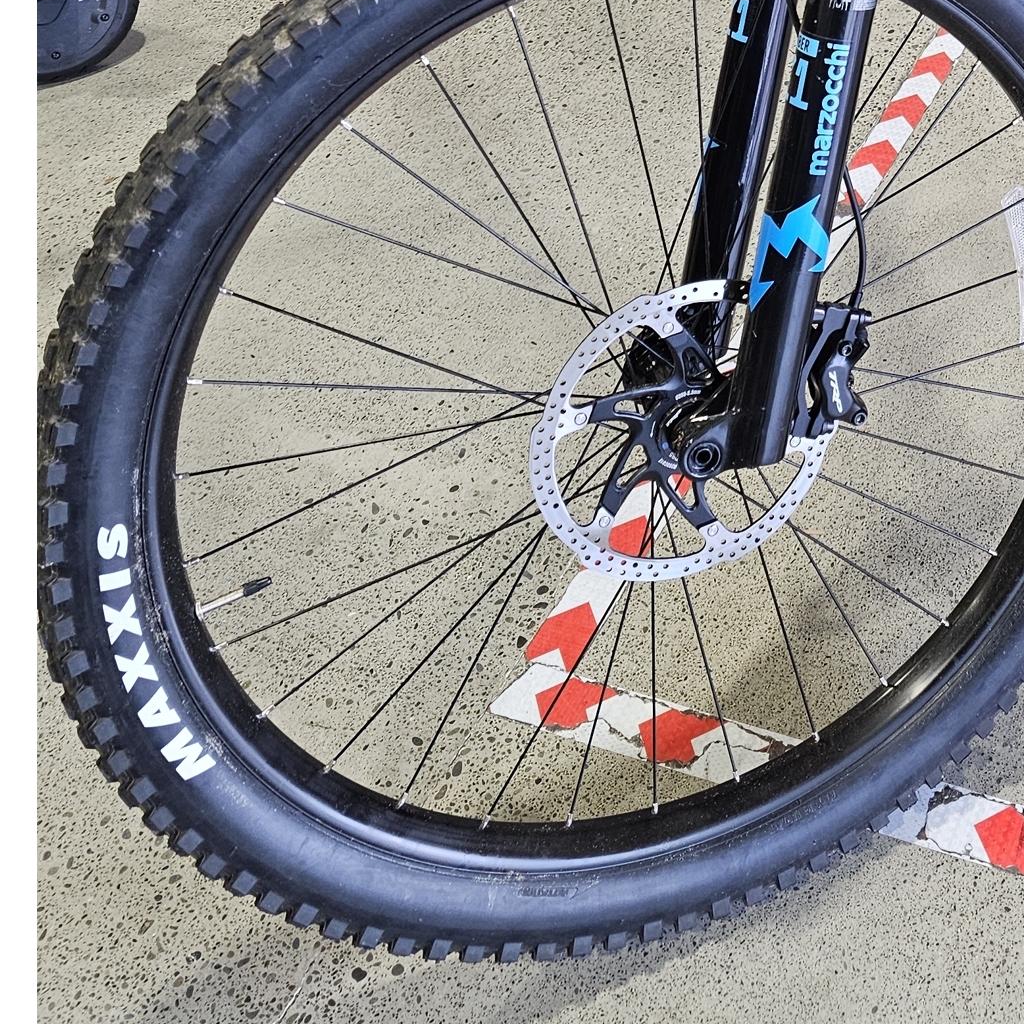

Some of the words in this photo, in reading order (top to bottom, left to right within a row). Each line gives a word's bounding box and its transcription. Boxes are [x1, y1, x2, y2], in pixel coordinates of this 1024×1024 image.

[809, 42, 850, 176] marzocchi
[828, 370, 844, 413] TRP
[97, 523, 217, 782] MAXXIS
